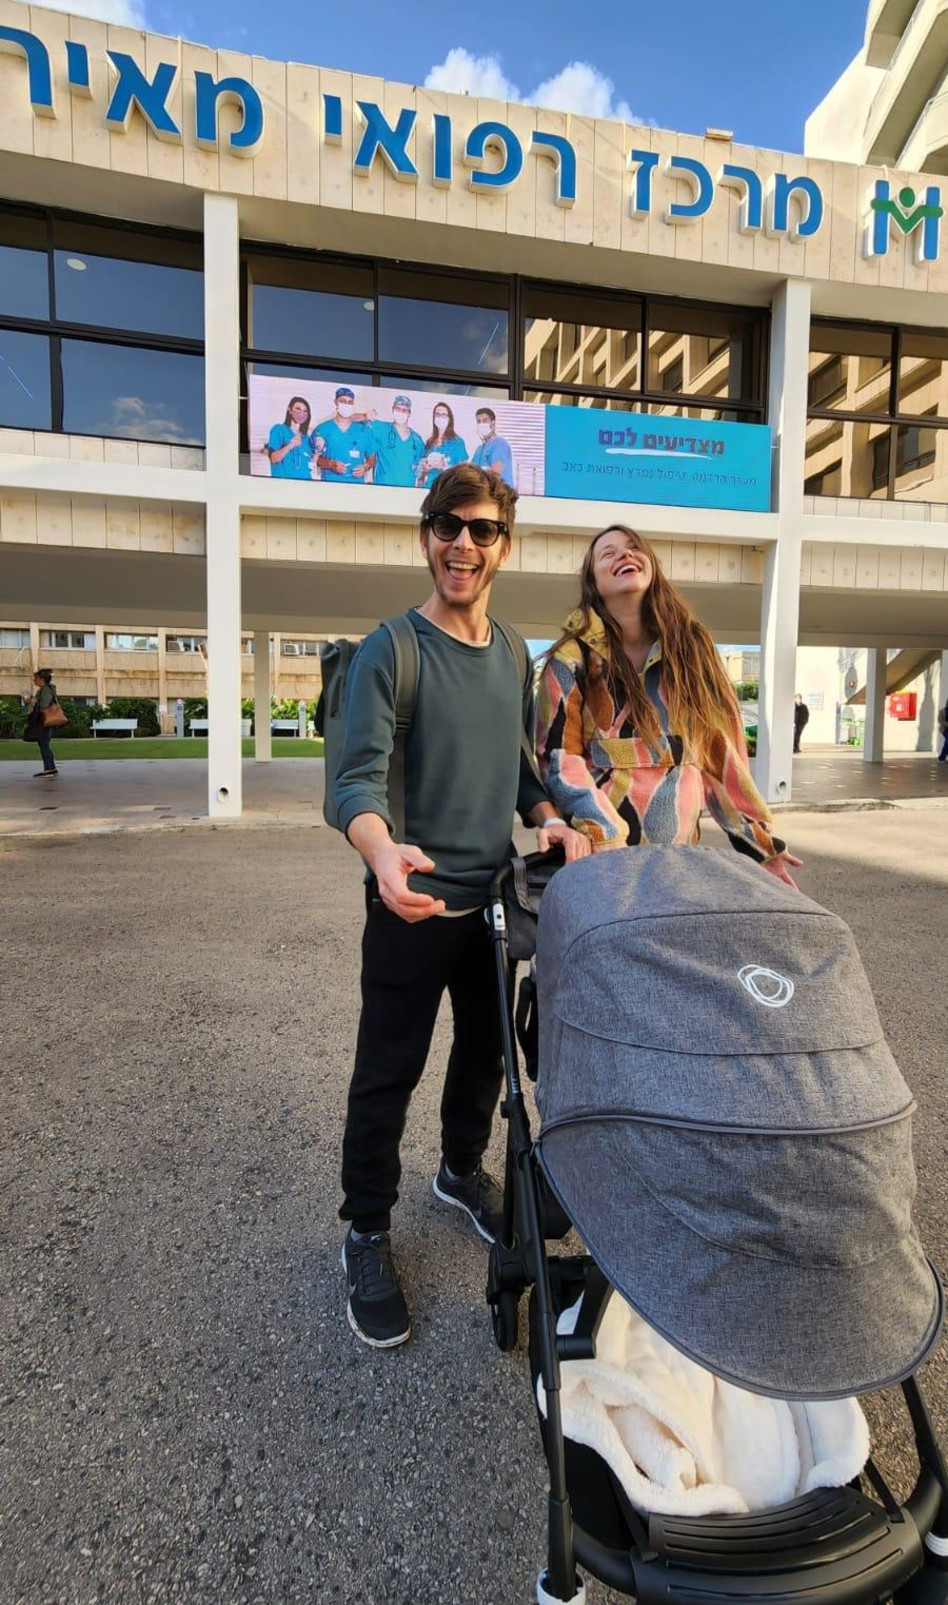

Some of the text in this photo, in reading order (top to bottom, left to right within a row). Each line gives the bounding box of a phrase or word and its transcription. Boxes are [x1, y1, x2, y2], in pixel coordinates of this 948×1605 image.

[0, 25, 824, 239] מרכז רפואי מאיר
[598, 427, 725, 455] מצדיעים לכם
[562, 461, 583, 473] כאב
[586, 463, 624, 476] ורפואת
[627, 467, 654, 479] נמרץ
[656, 467, 686, 480] טיפול
